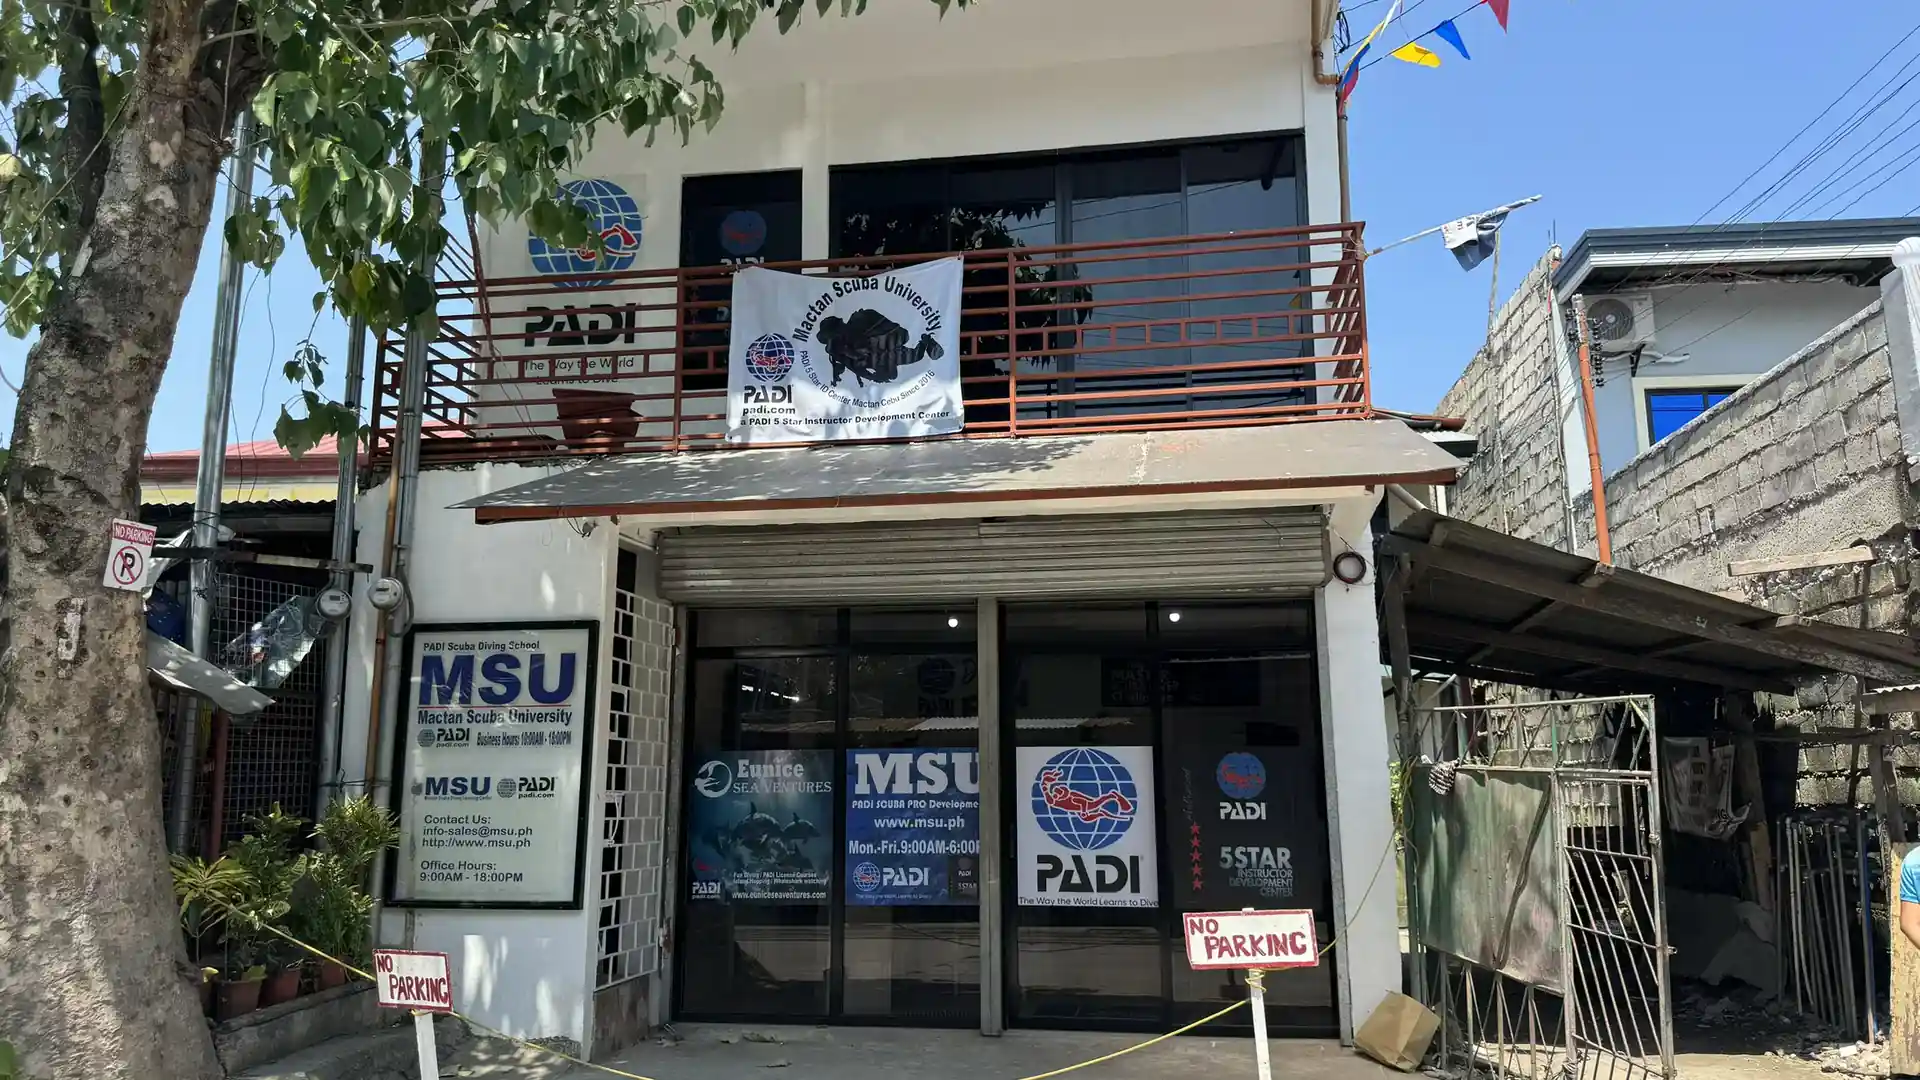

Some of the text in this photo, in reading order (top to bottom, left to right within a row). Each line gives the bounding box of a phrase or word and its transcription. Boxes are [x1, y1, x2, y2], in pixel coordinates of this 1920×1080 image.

[792, 276, 941, 342] Mactan Scuba University
[525, 303, 636, 347] PADI
[525, 360, 544, 370] The
[800, 350, 809, 368] PADI
[808, 371, 821, 386] Star
[820, 384, 829, 393] ID
[828, 389, 851, 405] Center
[852, 398, 880, 408] Mactan
[881, 397, 900, 406] Cebu
[900, 384, 920, 399] Since
[919, 370, 935, 386] 2016
[743, 386, 793, 404] PADI
[742, 407, 796, 416] padi.com
[782, 417, 803, 426] Star
[805, 416, 852, 425] Instructor
[855, 412, 915, 423] Development
[918, 410, 949, 419] Center
[115, 526, 154, 544] NO PARKING
[424, 641, 539, 651] PADI Scuba Diving School
[419, 653, 576, 705] MSU
[418, 709, 572, 726] Mactan Scuba University
[436, 728, 470, 741] PADI
[477, 732, 501, 746] Business
[737, 759, 804, 780] Eunice
[855, 753, 979, 794] MSU
[426, 777, 490, 795] MSU
[518, 777, 555, 791] PADI
[733, 781, 832, 793] SEA VENTURES
[852, 800, 874, 809] PADI
[876, 800, 906, 809] SCUBA
[909, 801, 926, 809] PRO
[1220, 802, 1266, 820] PADI
[424, 815, 491, 824] Contact Us:
[874, 817, 965, 829] www.msu.ph
[423, 826, 533, 838] info-sales@msu.ph
[422, 838, 531, 849] http://www.msu.ph
[420, 861, 496, 870] Office Hours:
[1238, 868, 1293, 878] INSTRUCTOR
[420, 872, 463, 882] 9:00AM
[473, 872, 523, 882] 18:00PM
[882, 868, 929, 886] PADI
[1037, 855, 1140, 893] PADI
[692, 882, 720, 894] PADI
[1229, 878, 1293, 887] DEVELOPMENT
[1036, 897, 1055, 905] Way
[1140, 899, 1158, 907] Dive
[1190, 918, 1218, 935] NO
[1204, 931, 1307, 960] PARKING
[377, 955, 393, 972] NO
[389, 974, 448, 1004] PARKING
